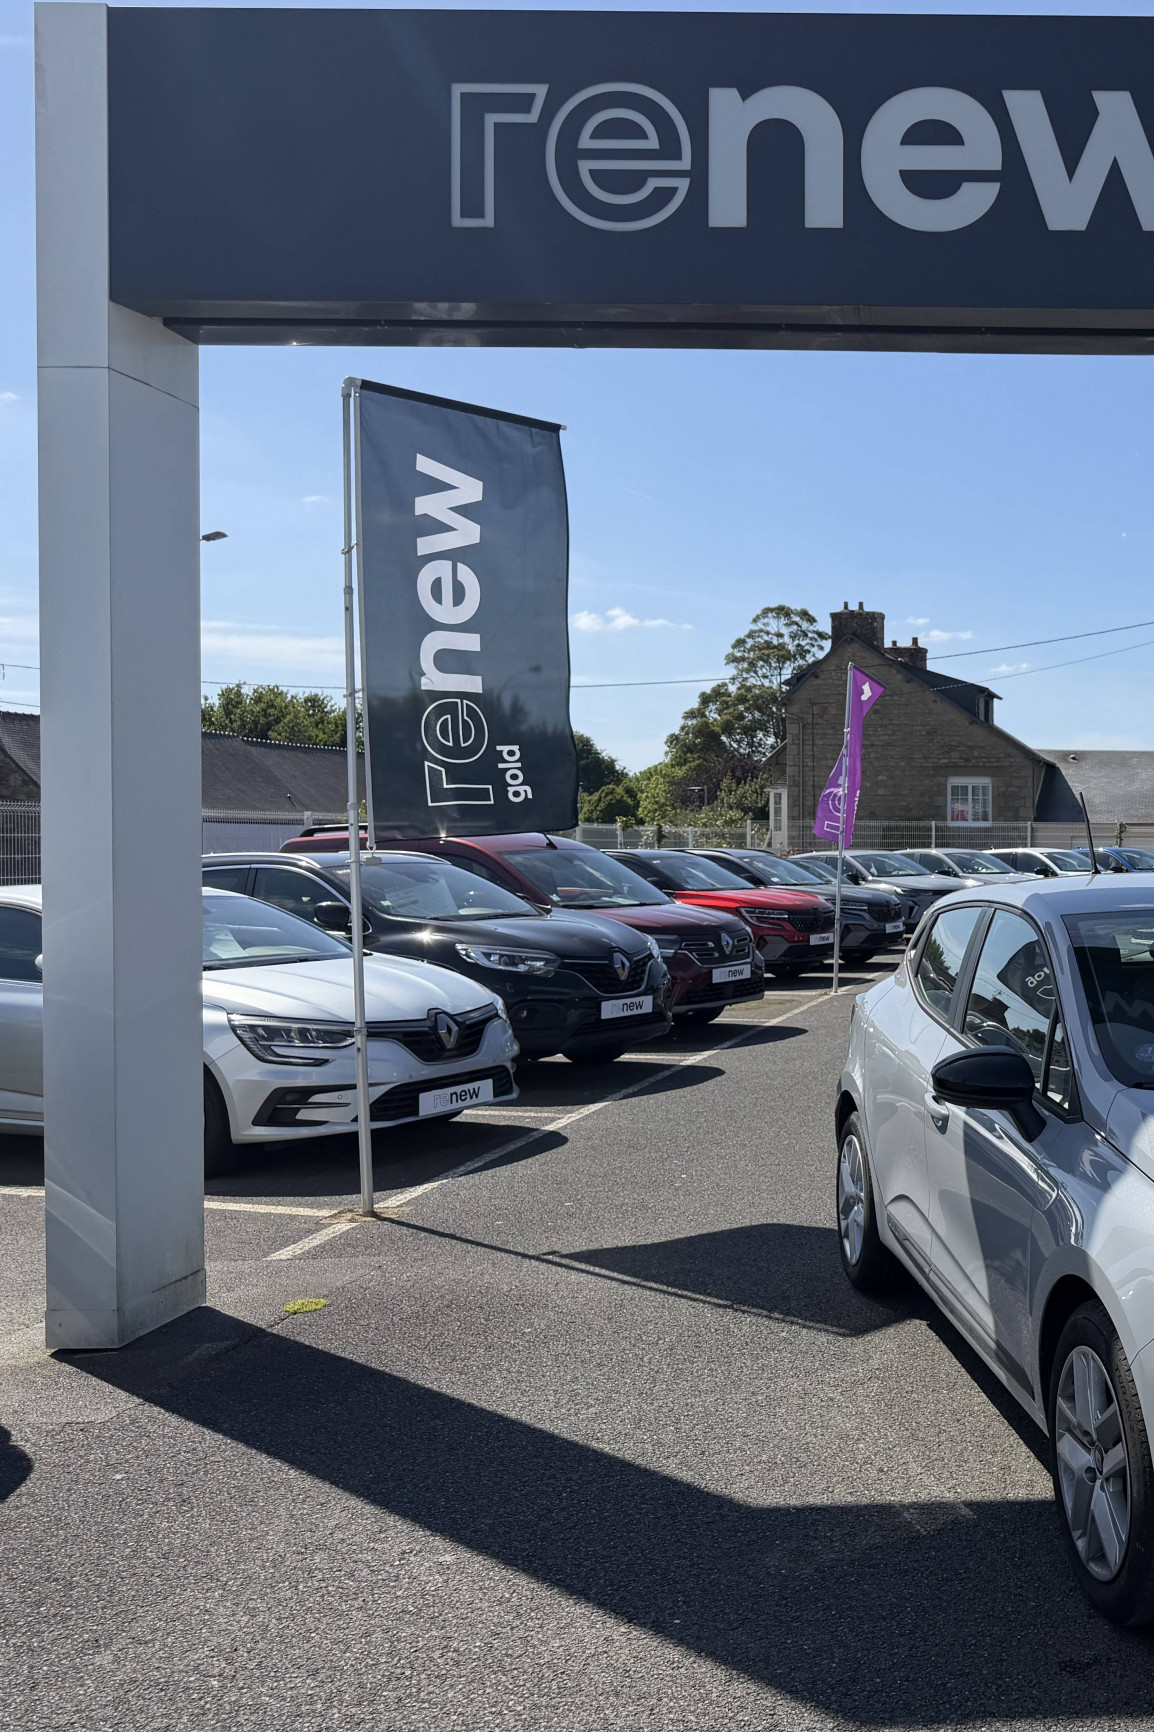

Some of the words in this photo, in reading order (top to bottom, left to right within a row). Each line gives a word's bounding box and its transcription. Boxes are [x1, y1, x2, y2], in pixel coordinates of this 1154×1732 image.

[415, 454, 494, 806] renew
[497, 746, 532, 802] gold
[610, 1000, 644, 1015] renew
[433, 1086, 481, 1109] renew
